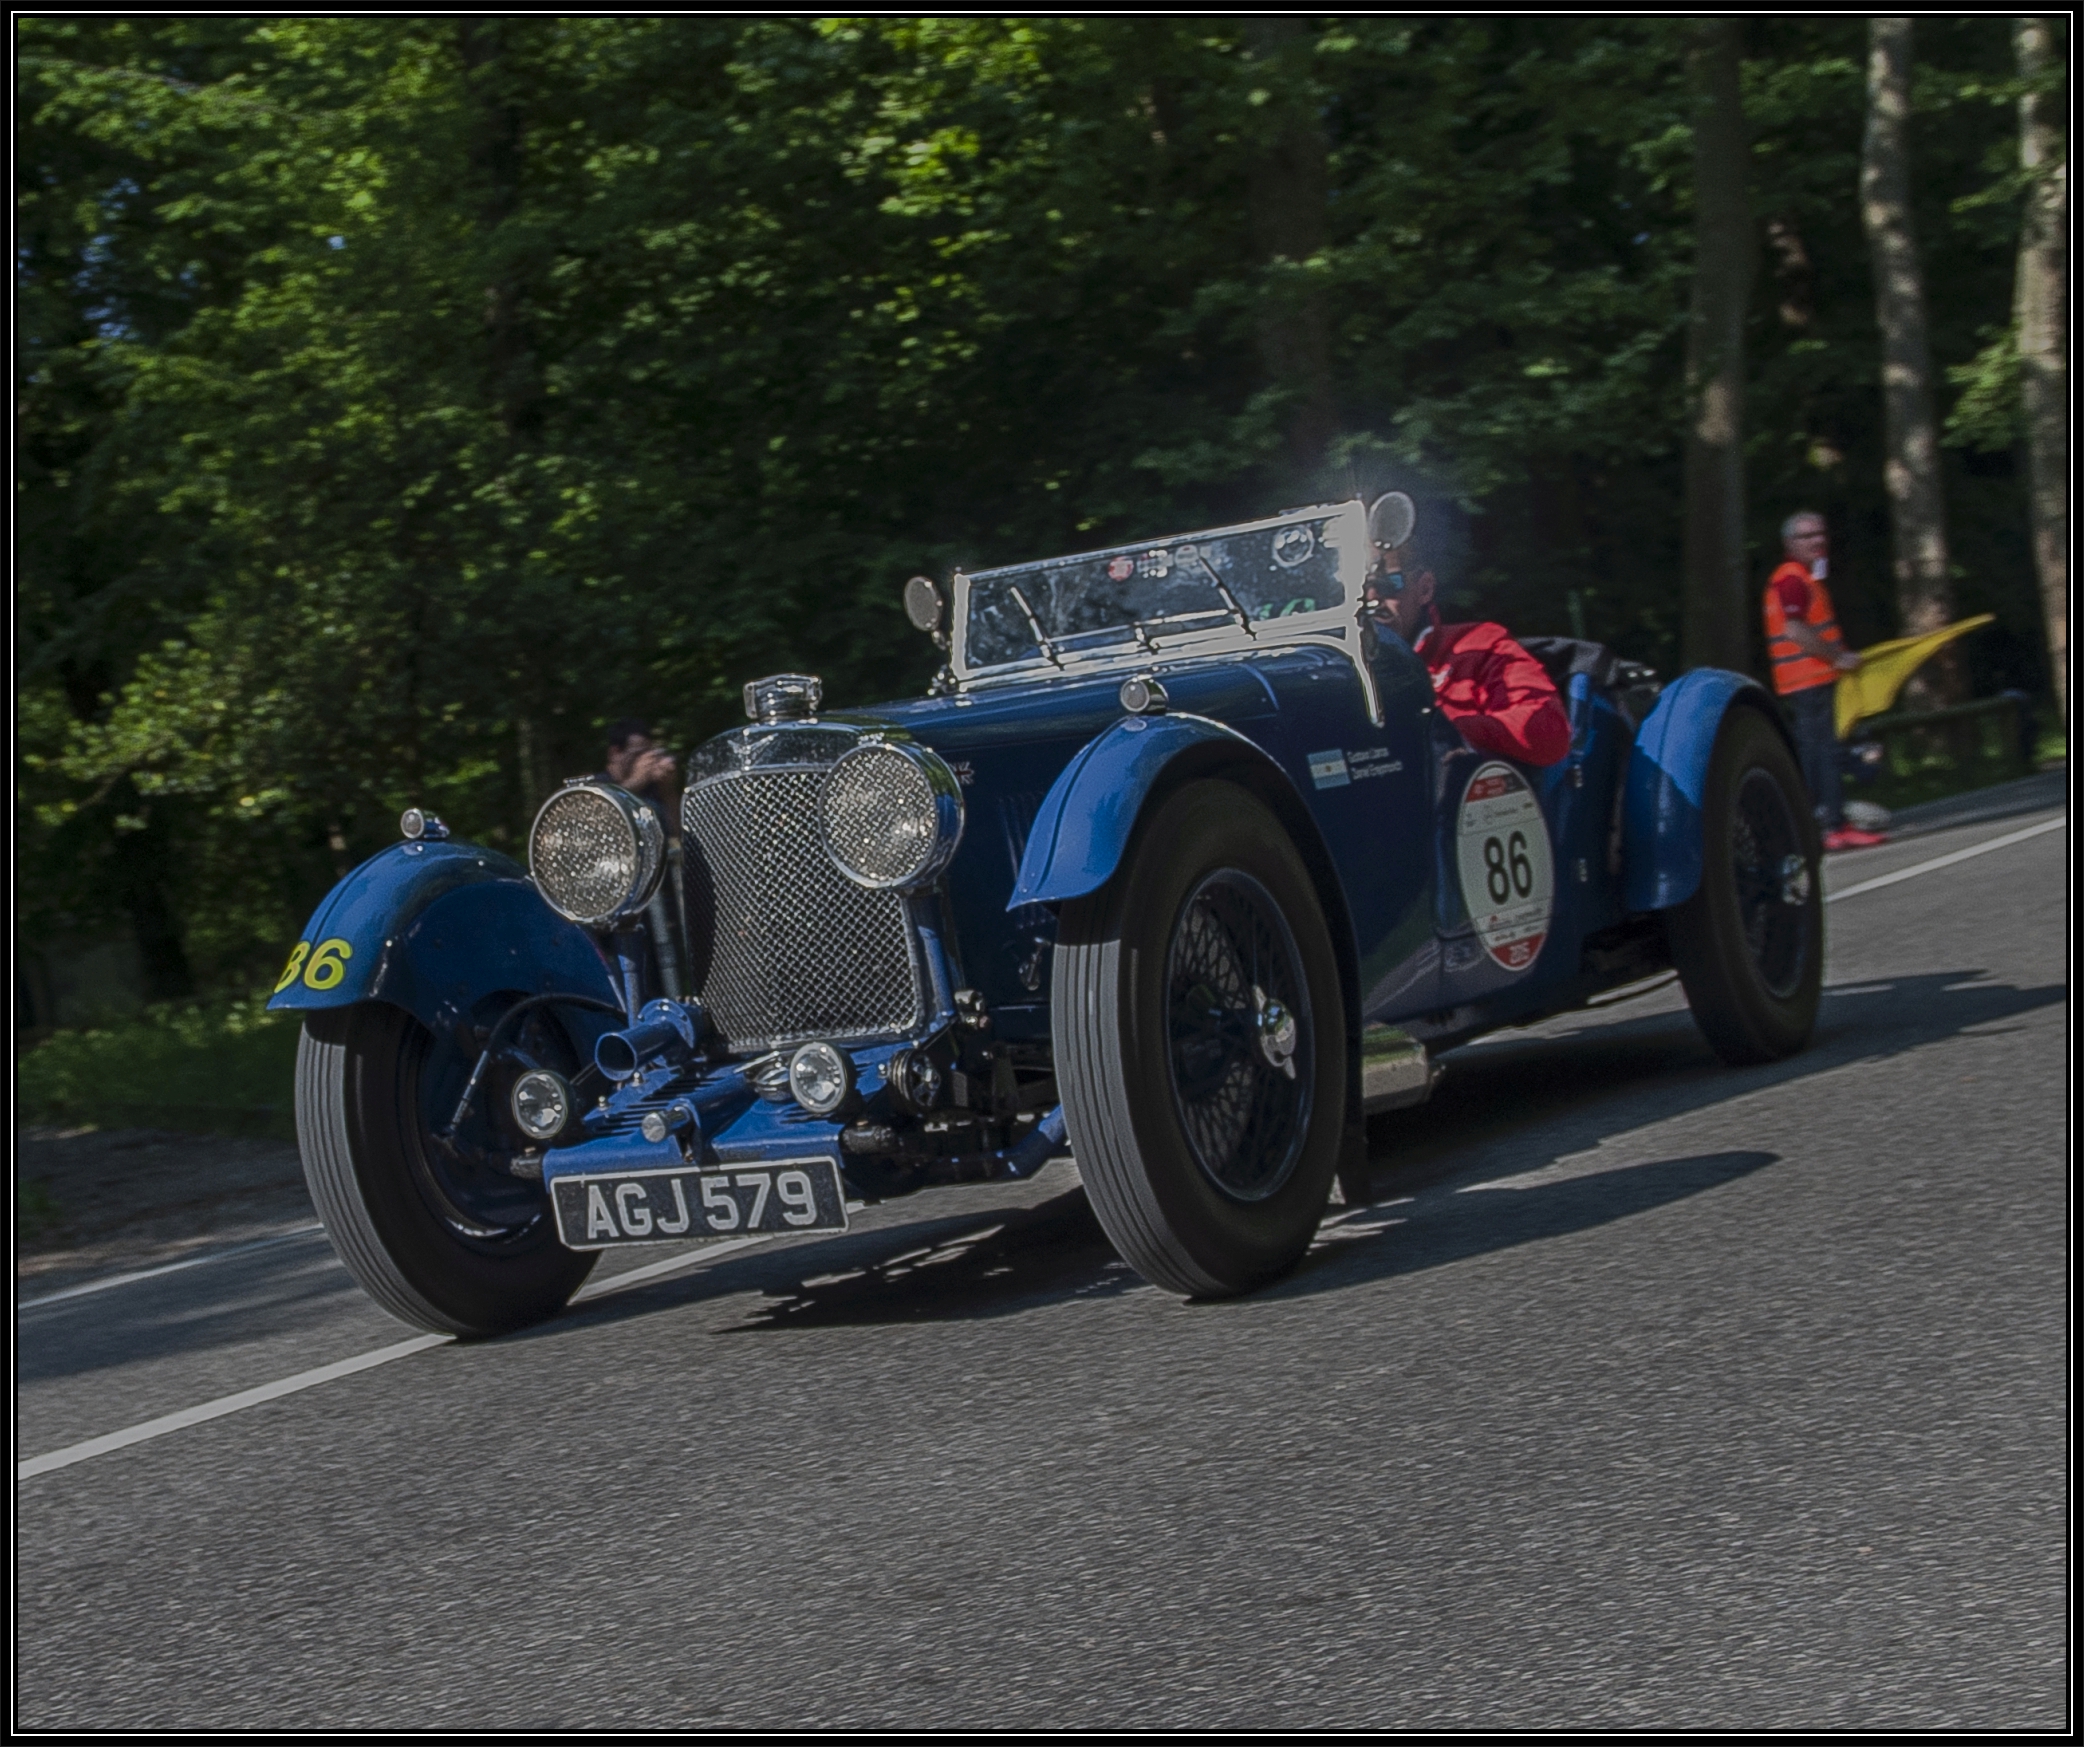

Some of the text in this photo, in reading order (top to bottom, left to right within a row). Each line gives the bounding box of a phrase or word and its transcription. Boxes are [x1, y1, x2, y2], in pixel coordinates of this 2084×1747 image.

[1484, 831, 1533, 905] 86
[274, 938, 353, 994] 86
[586, 1171, 817, 1239] AGJ 579
